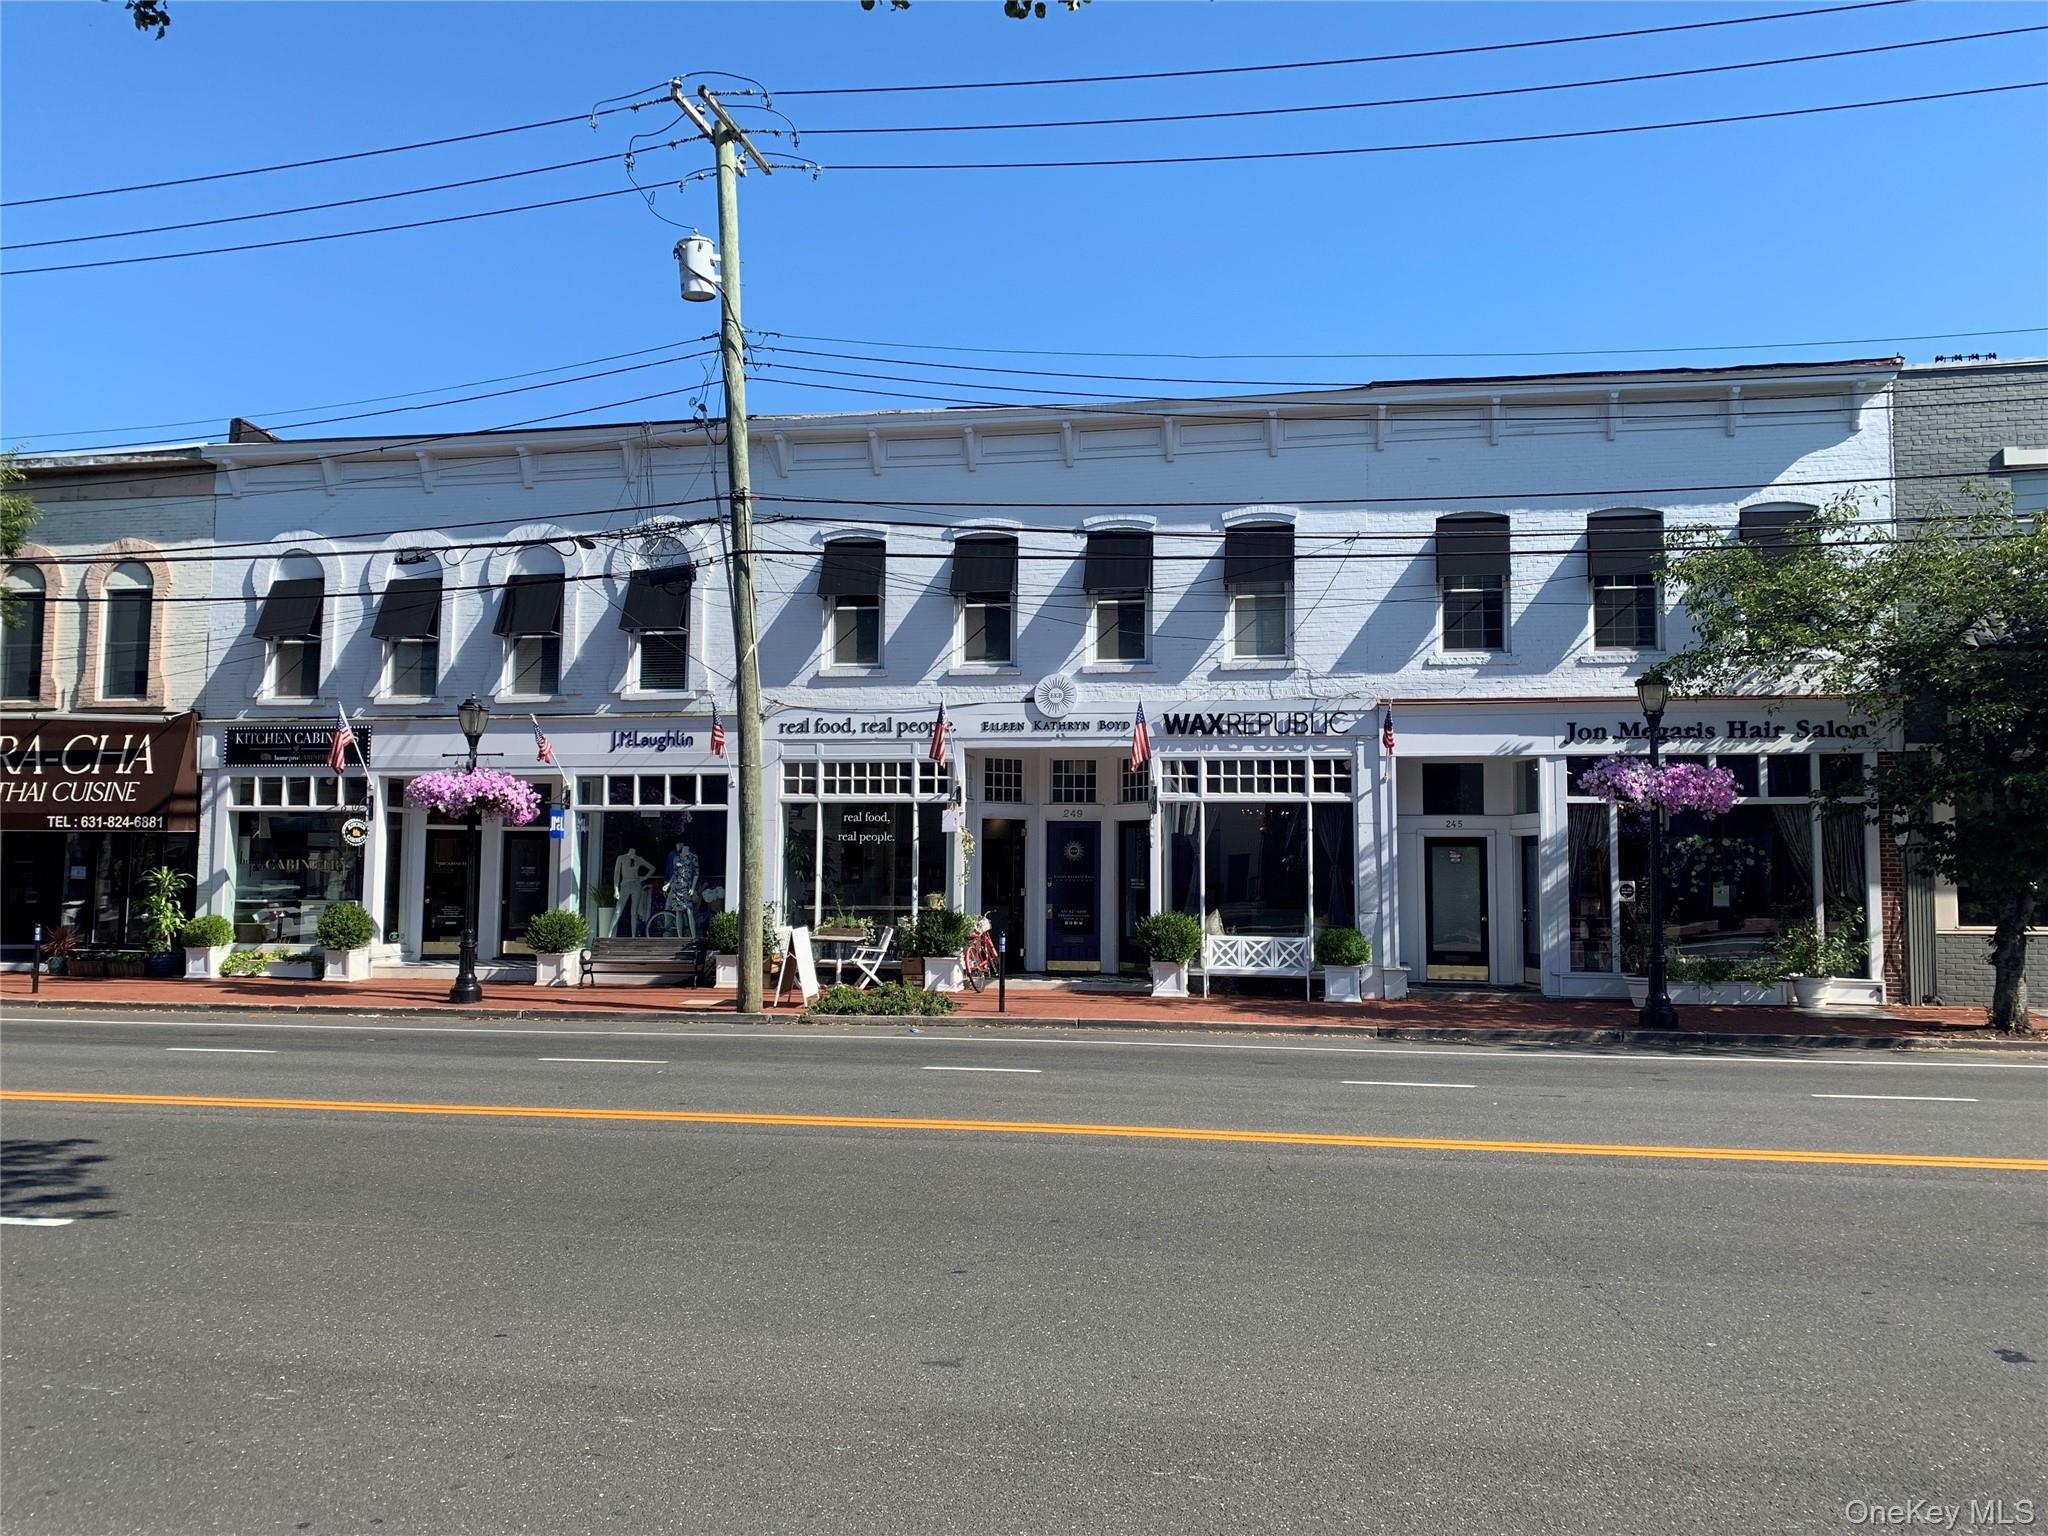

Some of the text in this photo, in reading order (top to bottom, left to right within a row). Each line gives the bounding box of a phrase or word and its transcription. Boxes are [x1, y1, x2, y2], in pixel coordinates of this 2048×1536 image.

[779, 717, 957, 738] real food, real peope.
[982, 720, 1131, 731] EILEEN KATHRYN BOYD
[1564, 722, 1608, 744] Jon
[1727, 720, 1785, 739] Hair
[1796, 719, 1870, 740] Salon
[235, 731, 359, 744] KITCHEN CABINS
[0, 781, 140, 802] THAI CUISINE
[843, 811, 890, 825] real food,
[1063, 809, 1083, 818] 249
[80, 816, 163, 828] 631-824-6881
[1446, 820, 1463, 828] 245
[838, 832, 895, 845] real people.
